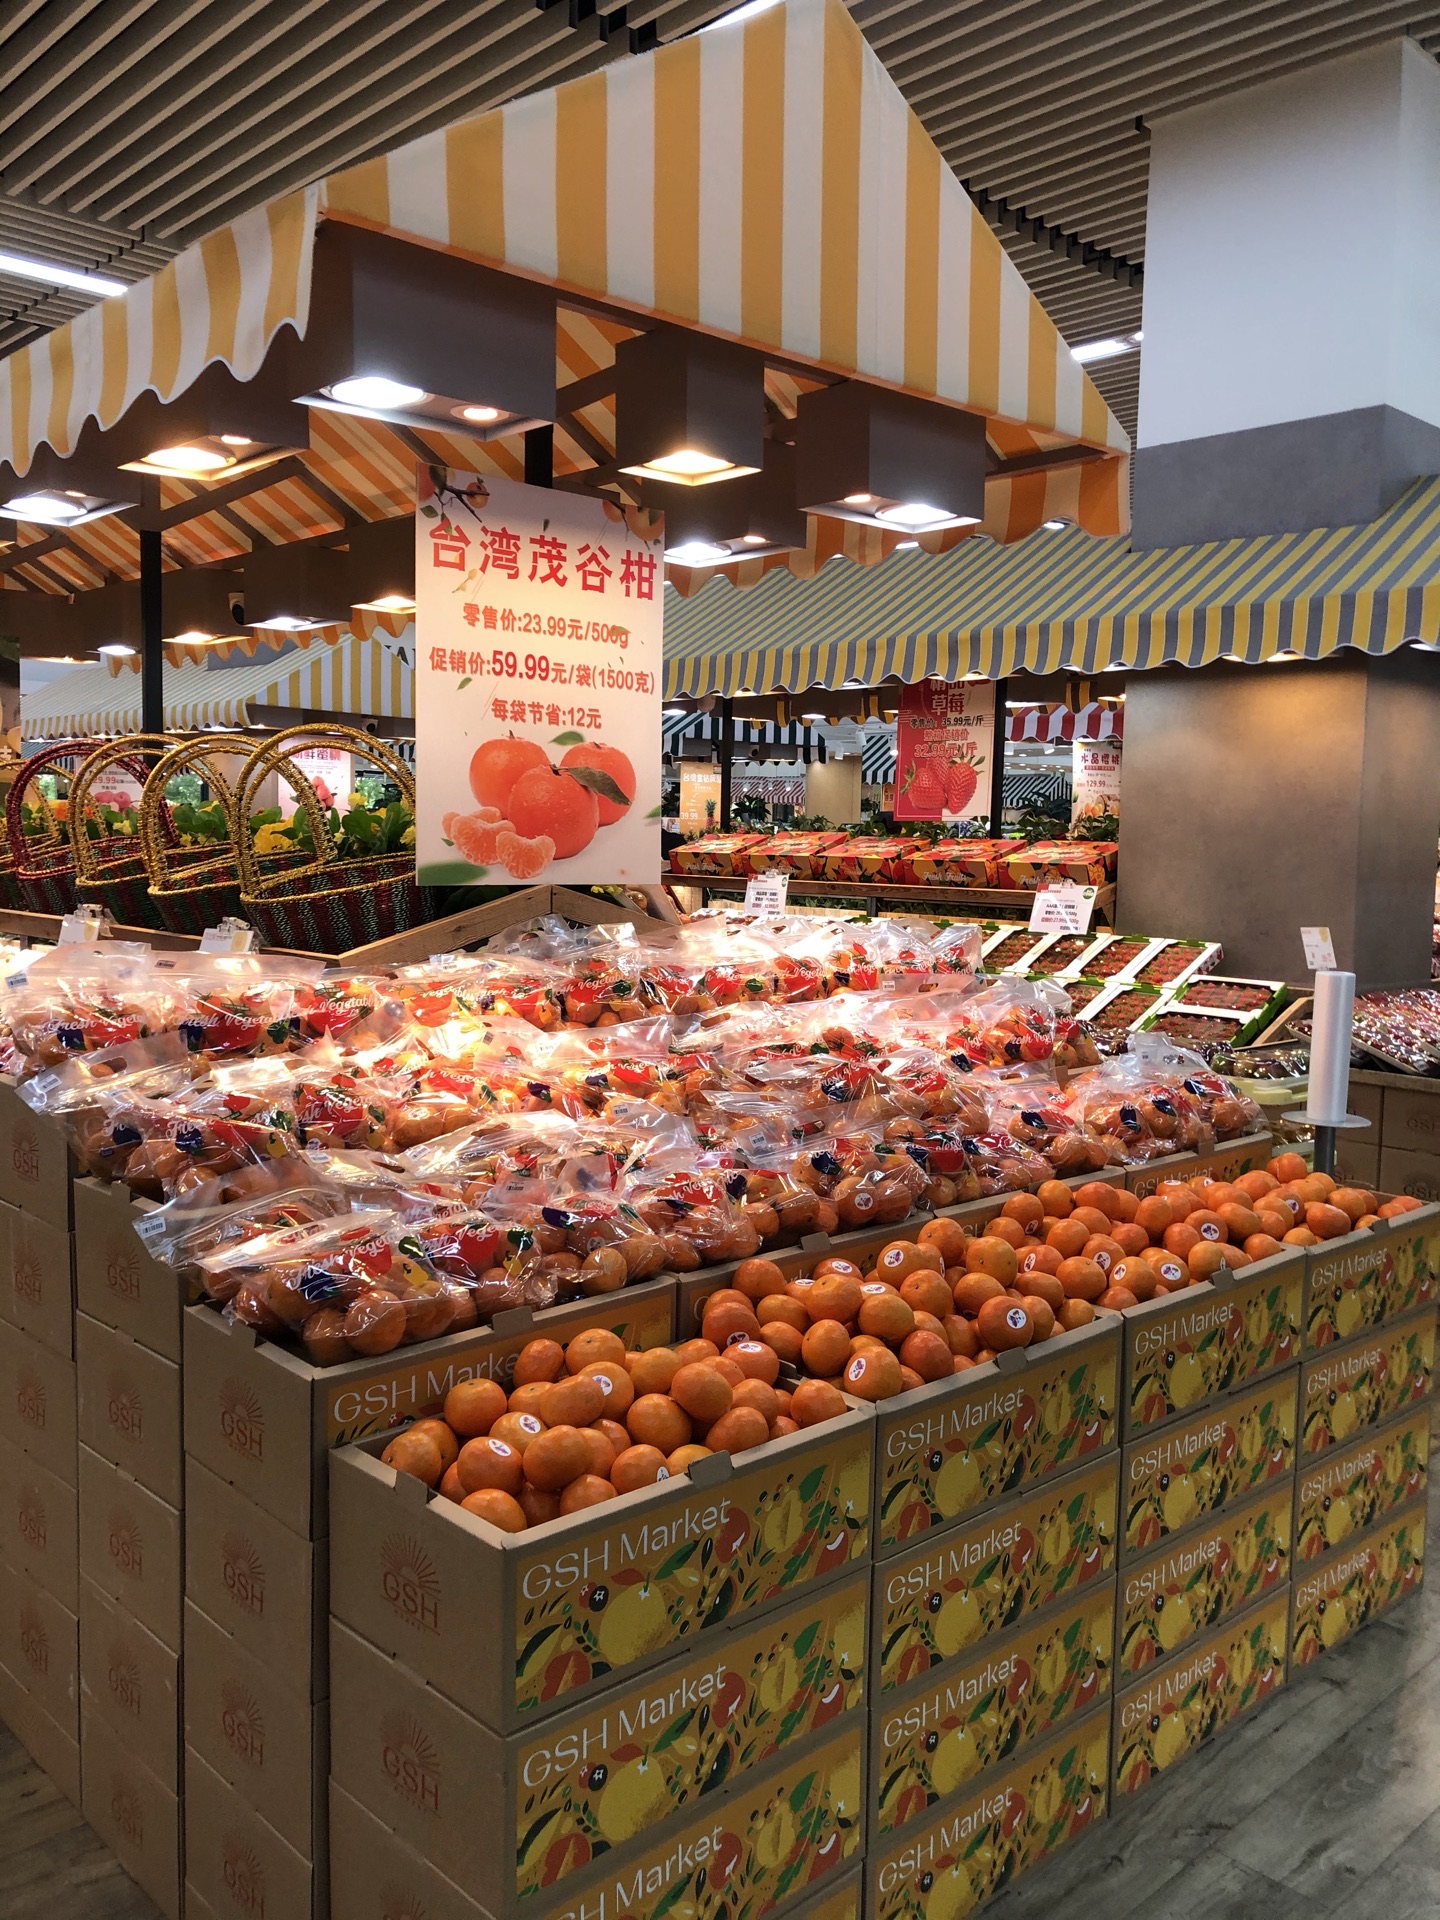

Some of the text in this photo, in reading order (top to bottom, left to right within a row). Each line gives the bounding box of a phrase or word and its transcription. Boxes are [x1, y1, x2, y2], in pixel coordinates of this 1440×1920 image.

[428, 518, 658, 600] 台湾茂谷柑
[463, 603, 629, 649] 零售价:23.99元/500g
[428, 646, 656, 695] 促销价:59.99元/袋(1500克)
[491, 697, 602, 730] 每袋节省:12元
[931, 693, 965, 716] 草莓
[13, 1149, 40, 1179] GSH
[14, 1271, 42, 1301] GSH
[107, 1263, 141, 1298] GSH
[1311, 1248, 1388, 1288] GSH Market
[1134, 1302, 1235, 1355] GSH Market
[334, 1353, 519, 1423] GSH Marke
[1307, 1348, 1382, 1395] GSH Market
[17, 1394, 46, 1427] GSH
[109, 1399, 142, 1438] GSH
[221, 1410, 263, 1457] GSH
[886, 1386, 1025, 1458] GSH Market
[1130, 1420, 1228, 1481] GSH Market
[1301, 1449, 1377, 1503] GSH Market
[109, 1532, 143, 1576] GSH
[522, 1497, 731, 1600] GSH Market
[887, 1521, 1022, 1604] GSH Market
[1125, 1535, 1223, 1605] GSH Market
[223, 1561, 264, 1613] GSH
[383, 1570, 438, 1629] GSH
[1296, 1548, 1371, 1609] GSH Market
[108, 1666, 141, 1714] GSH
[883, 1653, 1018, 1748] GSH Market
[1121, 1651, 1218, 1728] GSH Market
[222, 1710, 264, 1766] GSH
[523, 1662, 727, 1787] GSH Market
[383, 1745, 439, 1811] GSH
[878, 1786, 1013, 1893] GSH Market
[615, 1823, 724, 1914] Market
